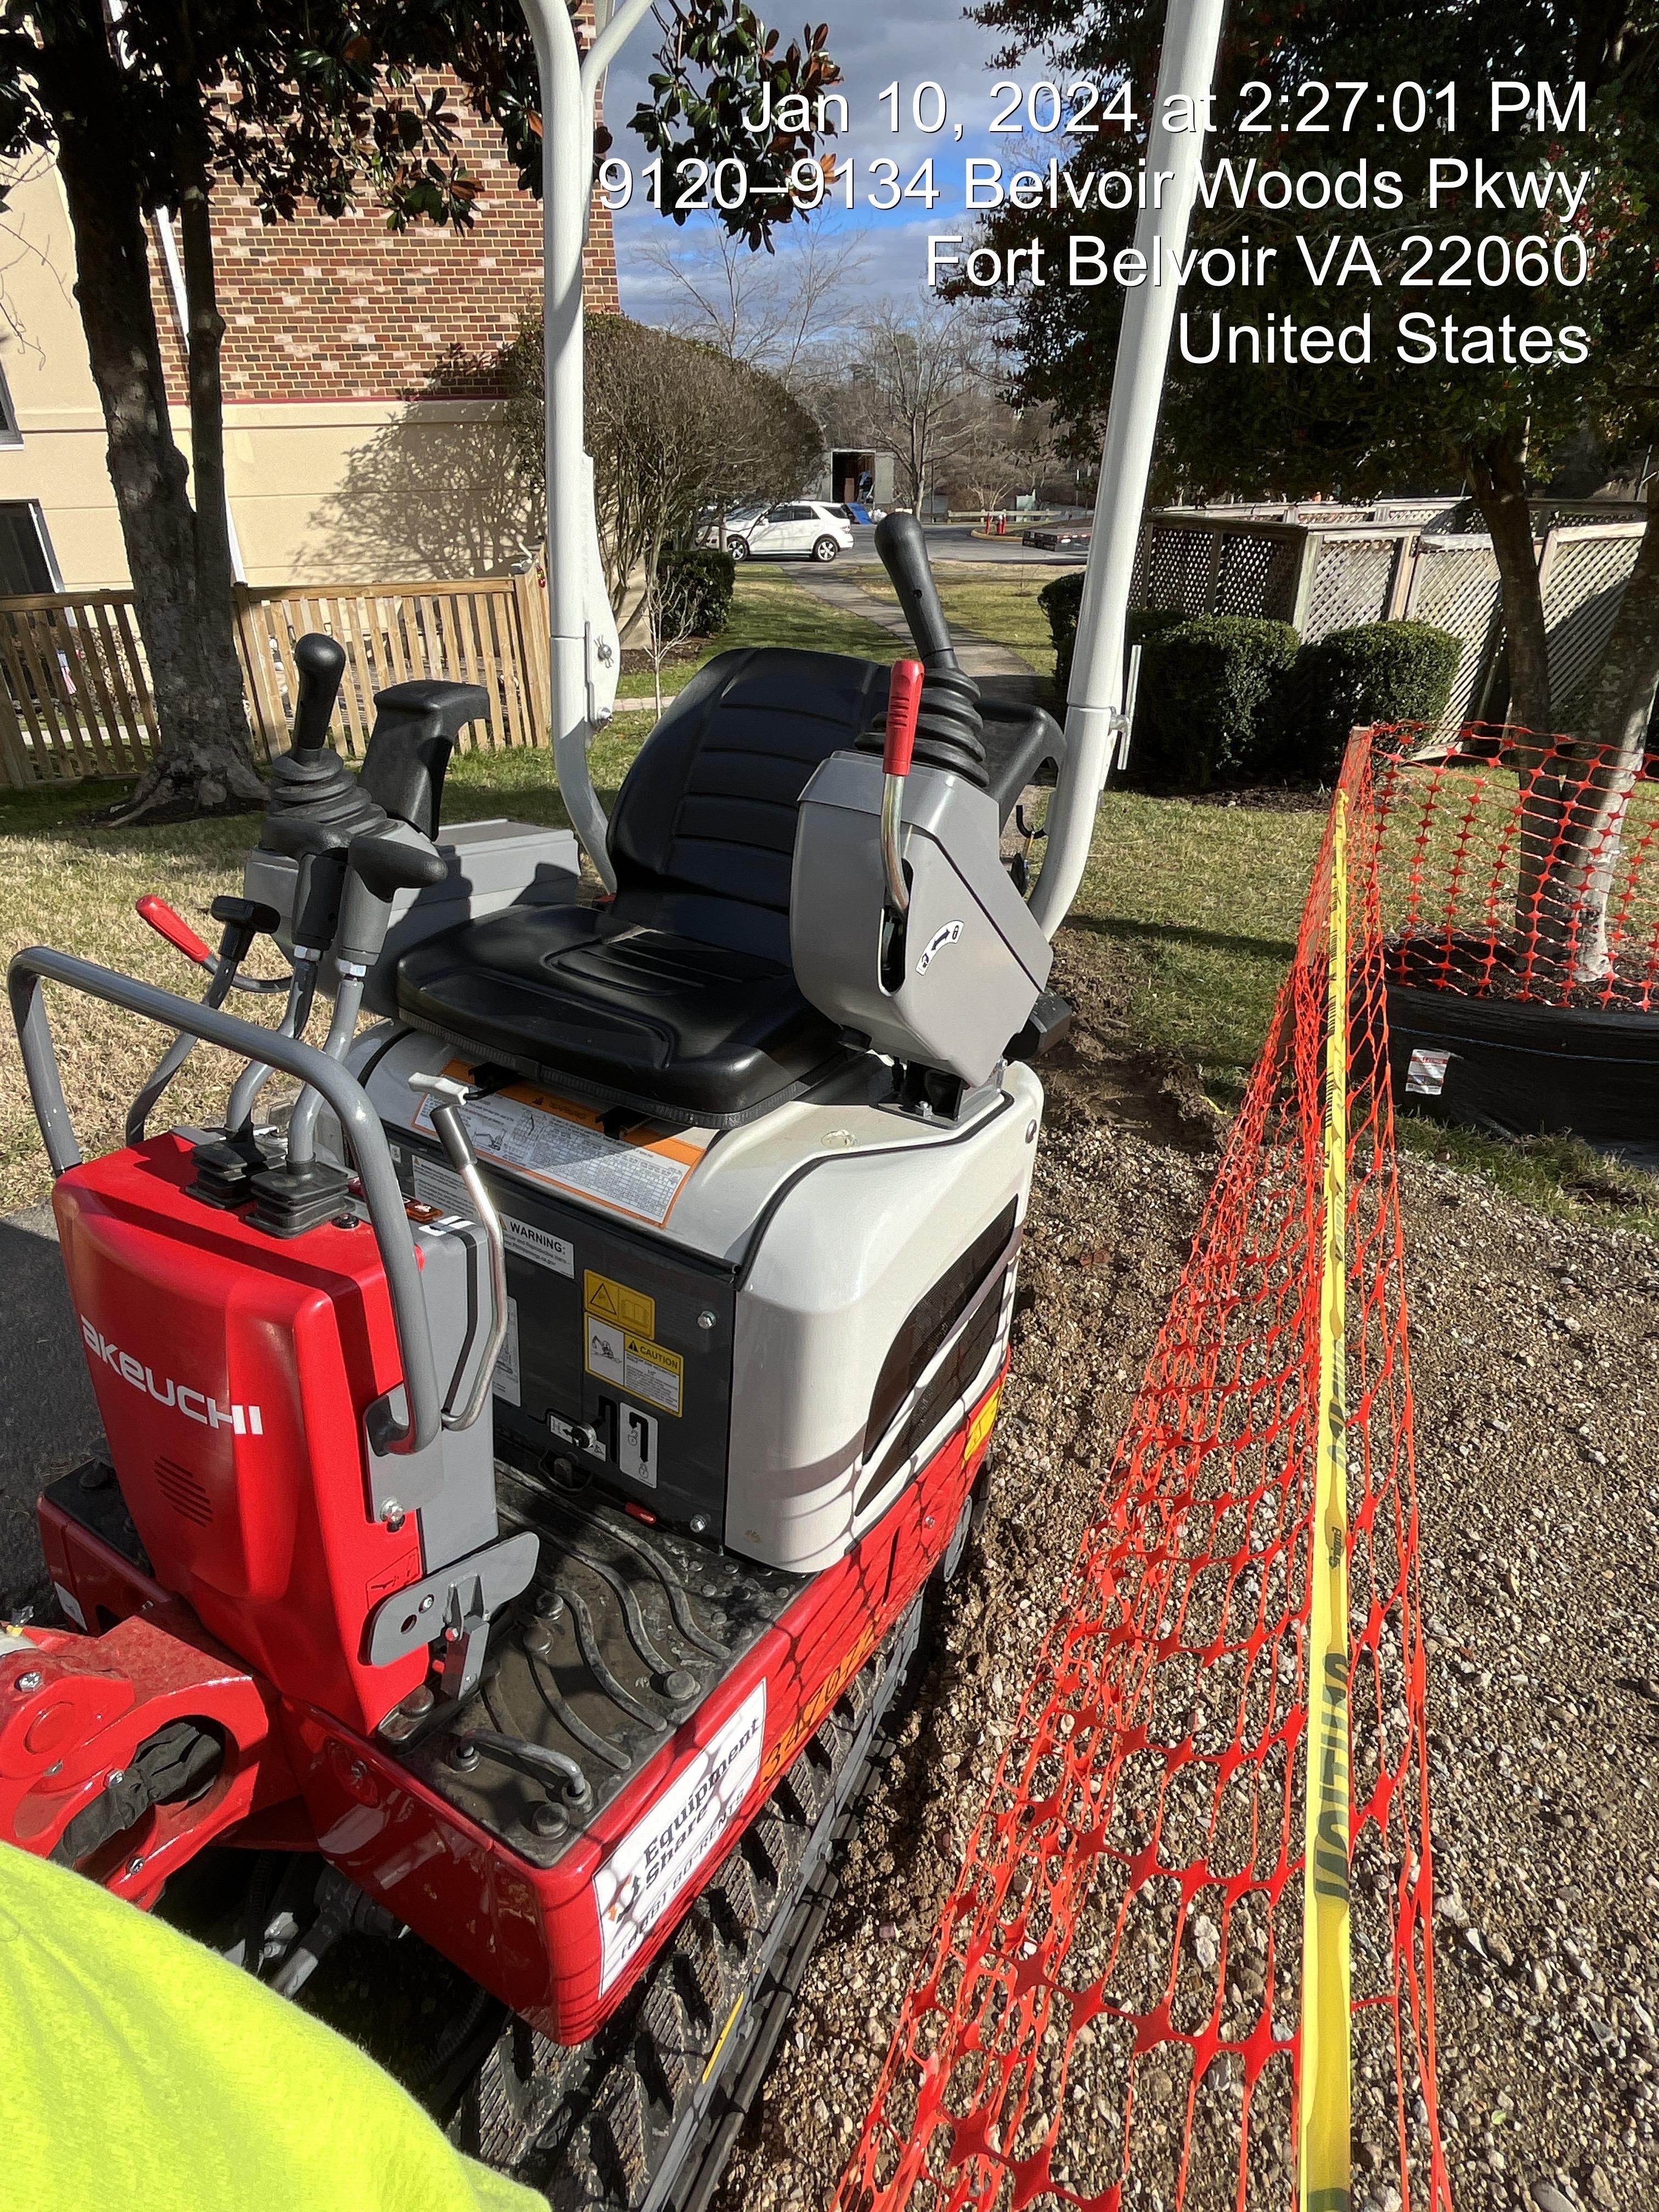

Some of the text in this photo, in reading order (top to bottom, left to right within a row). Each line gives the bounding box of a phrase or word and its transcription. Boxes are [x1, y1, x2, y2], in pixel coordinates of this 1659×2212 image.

[510, 1221, 566, 1255] WARNING:
[640, 1345, 678, 1370] CAUTION
[644, 1717, 759, 1870] Equipment
[646, 1802, 708, 1890] Share
